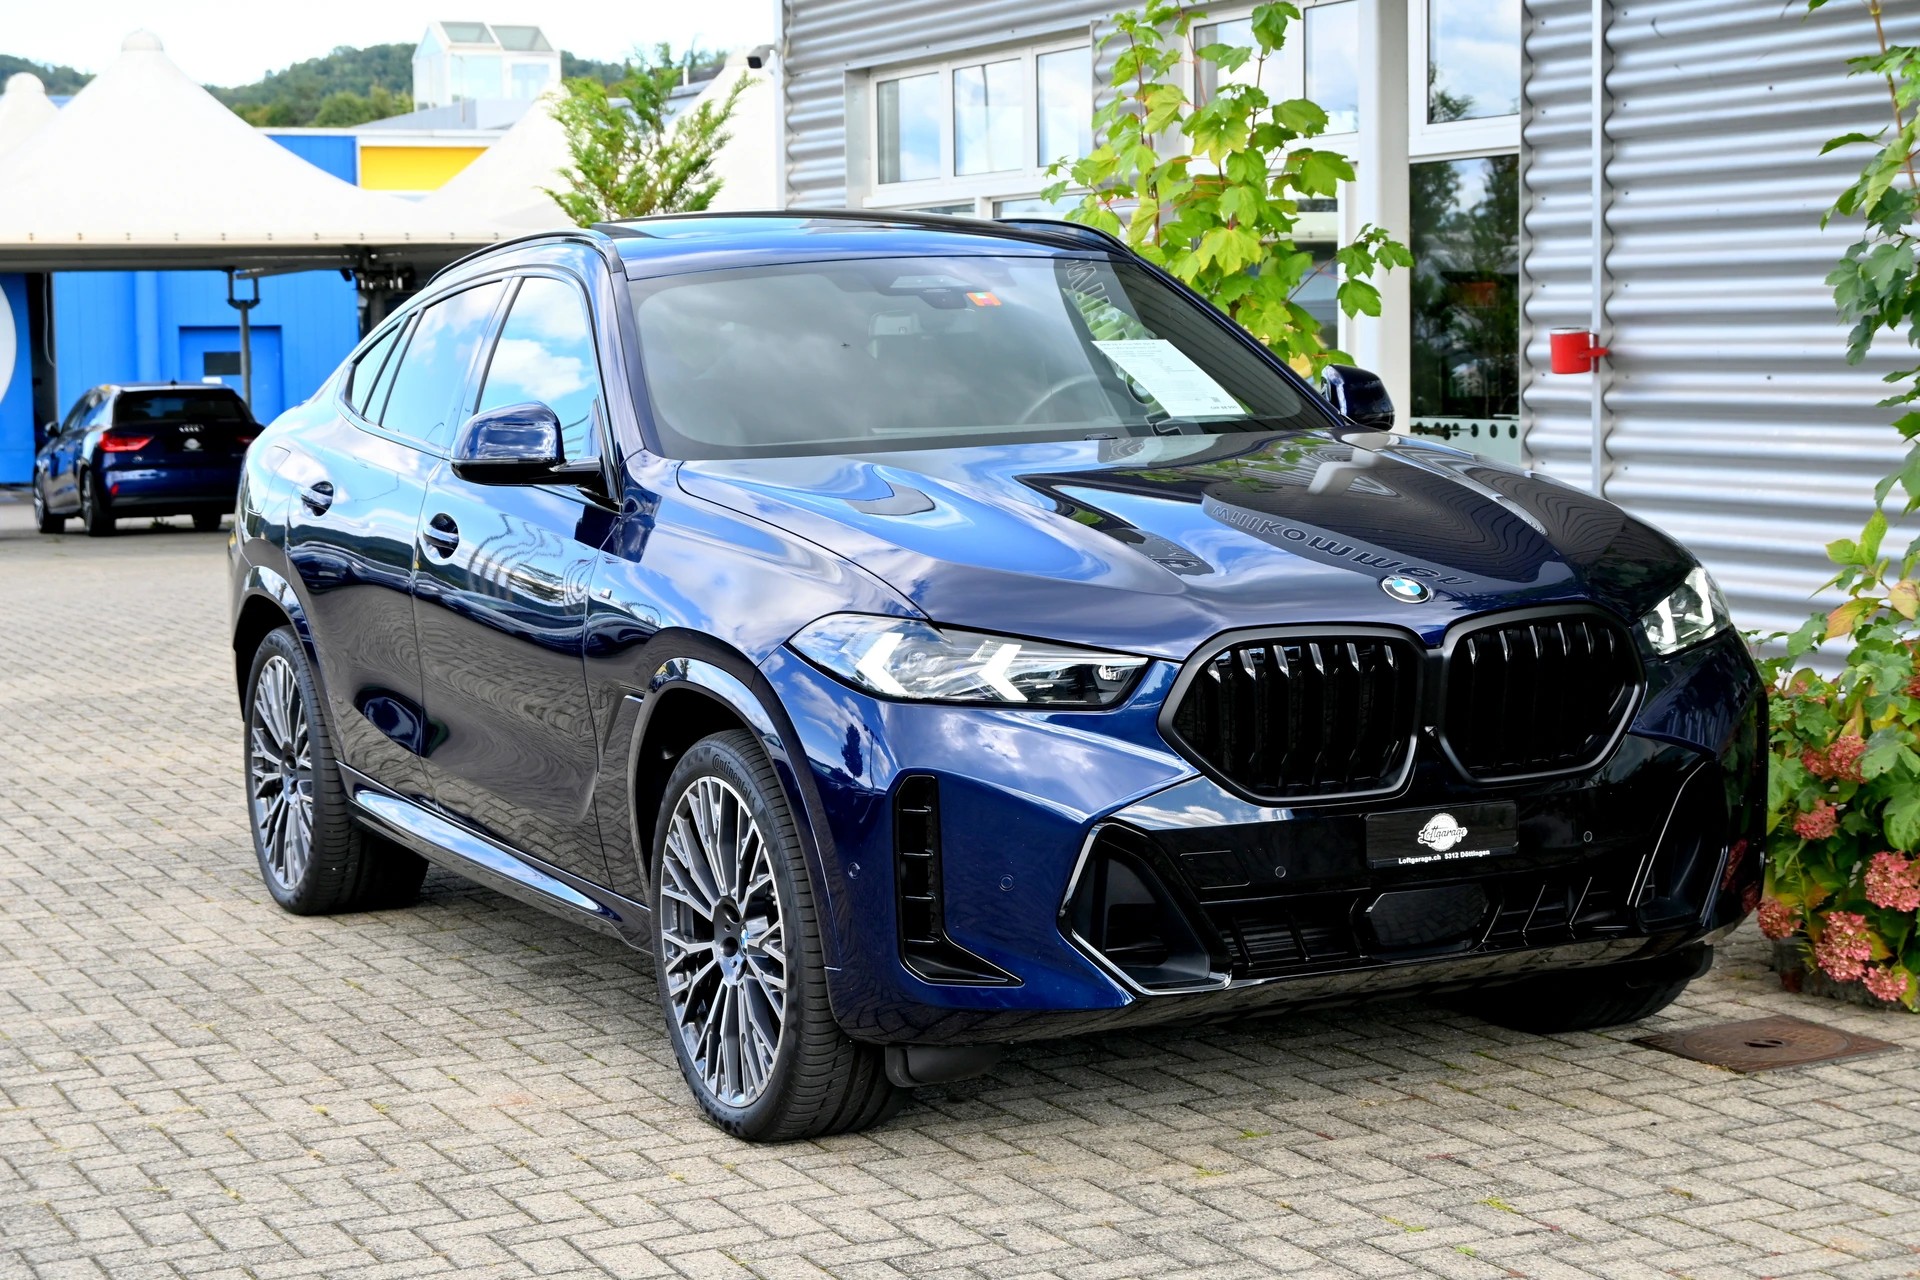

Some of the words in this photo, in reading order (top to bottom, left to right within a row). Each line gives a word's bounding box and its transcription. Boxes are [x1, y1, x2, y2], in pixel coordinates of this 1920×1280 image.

[712, 754, 752, 801] Continental
[1418, 824, 1467, 844] Loftgarage
[1398, 854, 1442, 864] Loftgarage.ch
[1444, 851, 1459, 859] 5312
[1460, 850, 1490, 858] Döttingen
